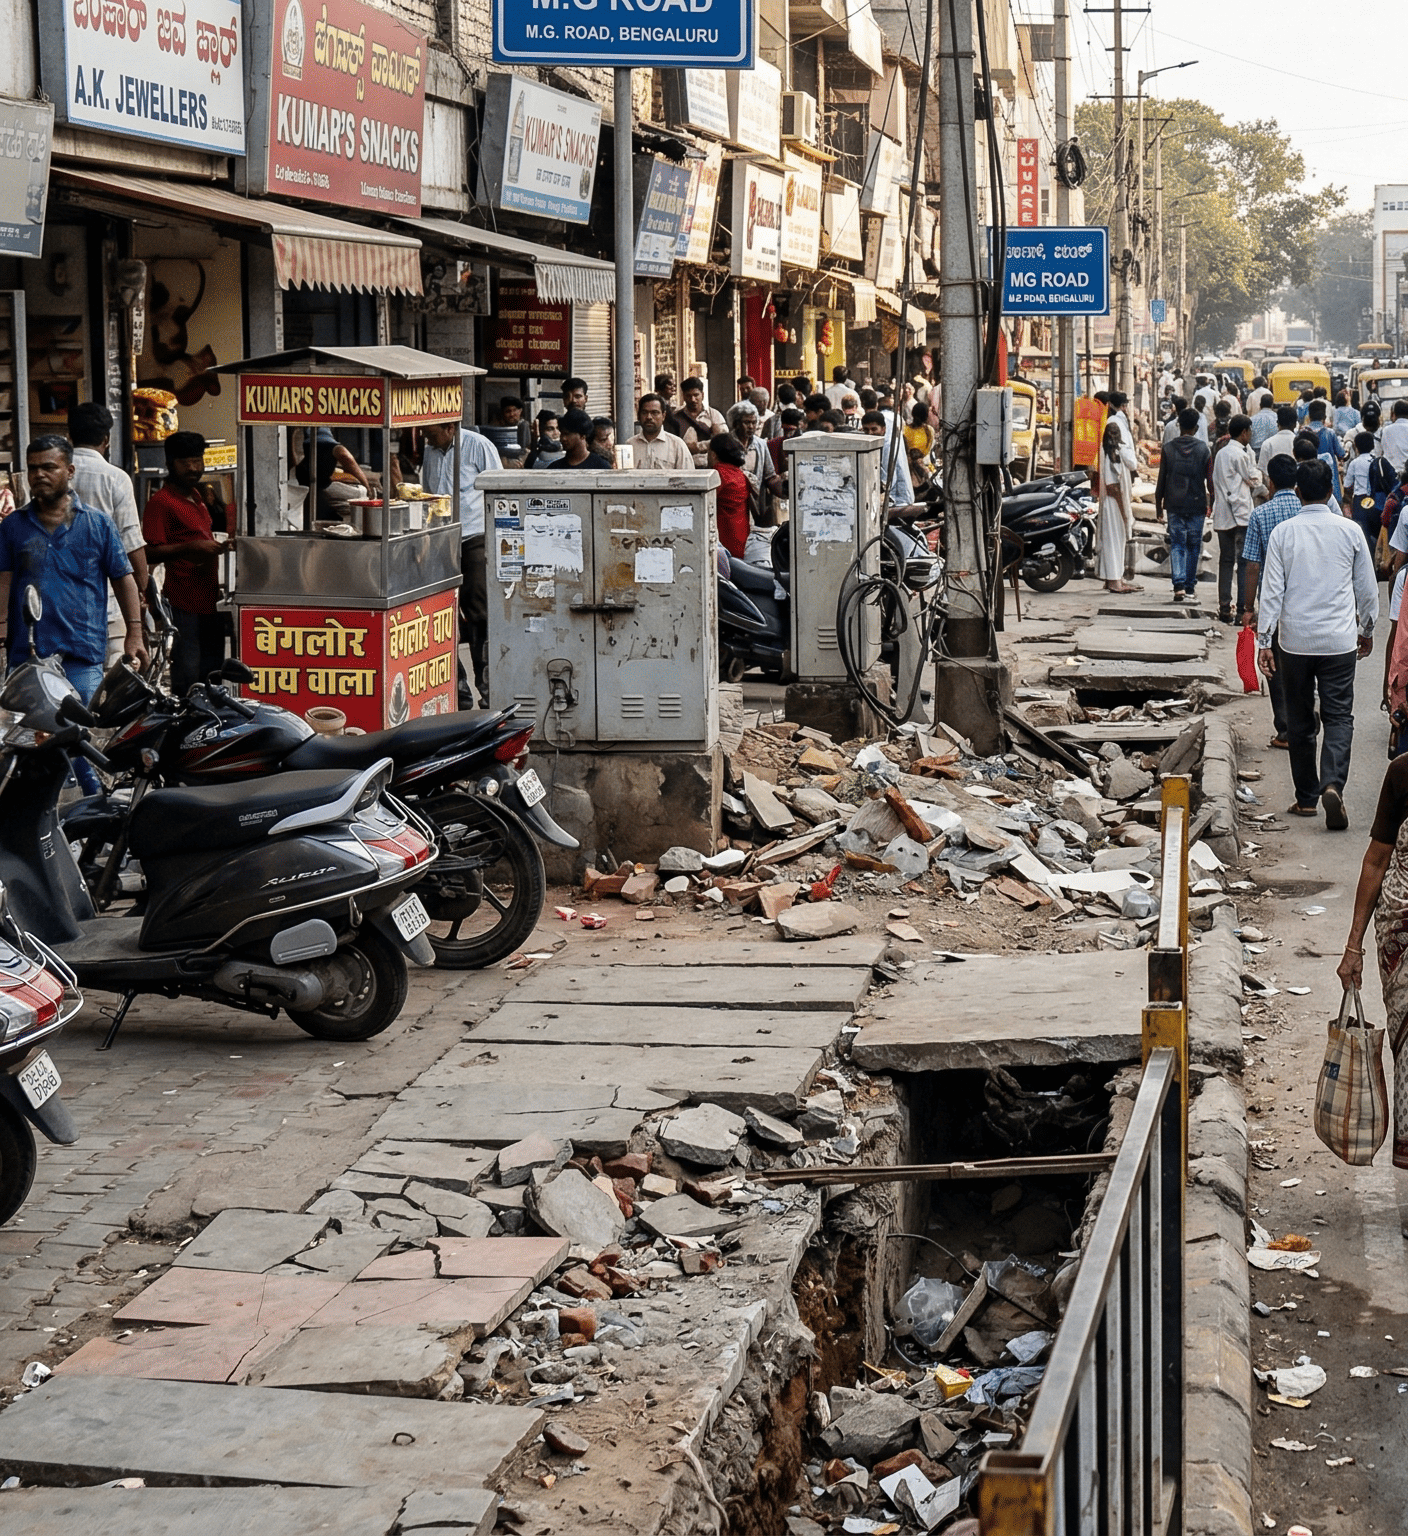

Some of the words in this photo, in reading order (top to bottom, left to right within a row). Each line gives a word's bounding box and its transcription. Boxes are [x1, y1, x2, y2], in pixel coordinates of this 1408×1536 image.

[526, 25, 559, 39] M.G.
[564, 25, 614, 43] ROAD,
[619, 27, 719, 43] BENGALURU
[74, 64, 110, 110] A.K.
[115, 74, 208, 130] JEWELLERS
[277, 93, 355, 159] KUMAR'S
[360, 116, 419, 174] SNACKS
[563, 127, 597, 168] SNACKS
[1010, 272, 1037, 287] MG
[1041, 272, 1089, 287] ROAD
[245, 385, 313, 415] KUMAR'S
[317, 387, 381, 417] SNACKS
[254, 616, 368, 657] बेंगलोर
[306, 668, 377, 696] वाला
